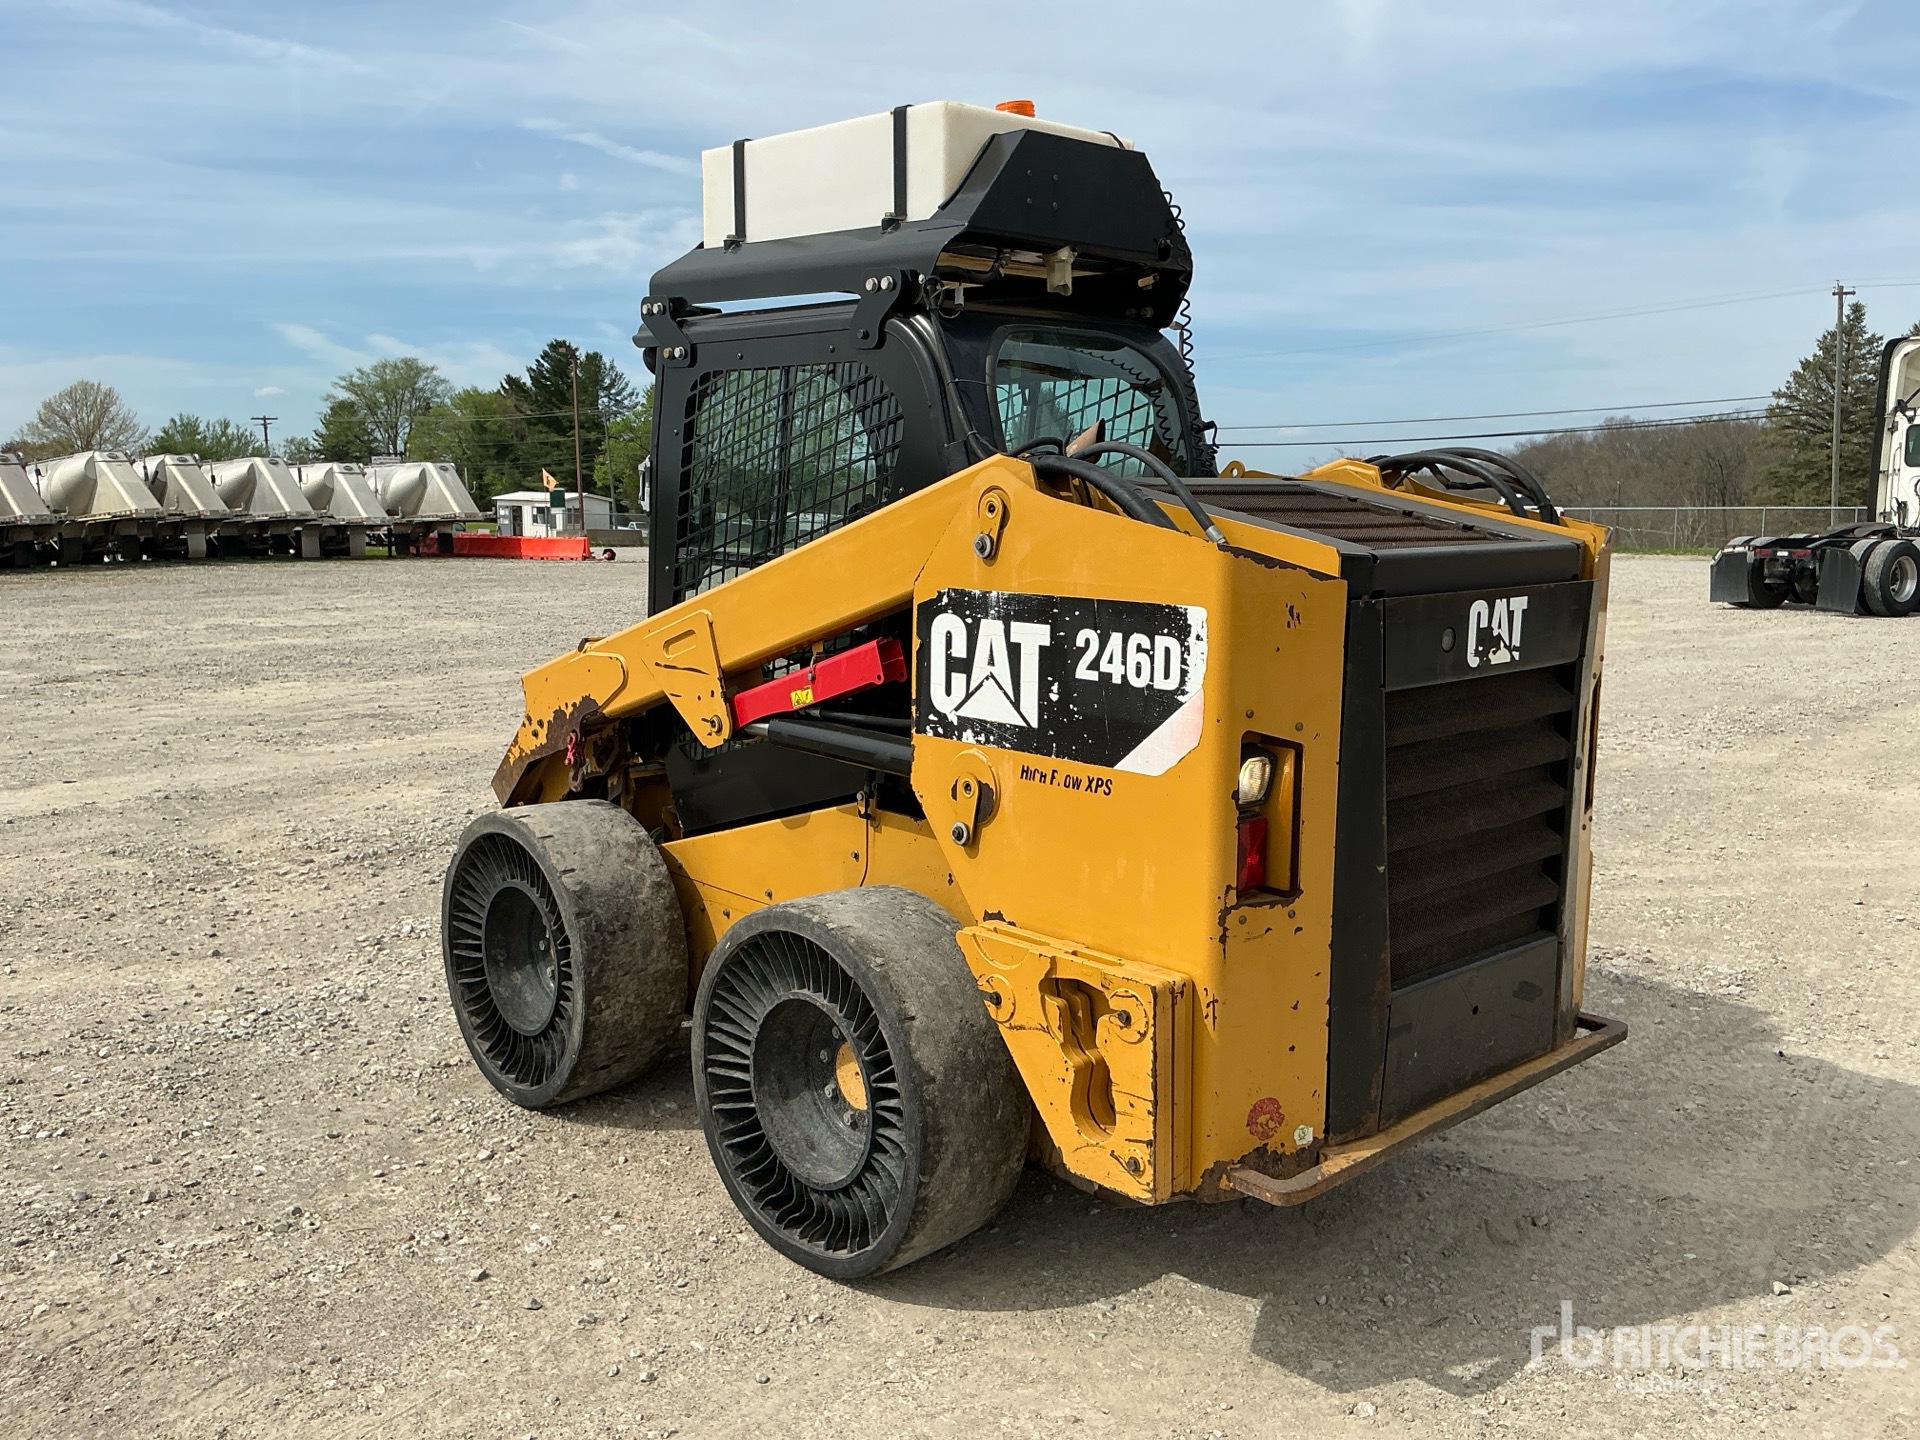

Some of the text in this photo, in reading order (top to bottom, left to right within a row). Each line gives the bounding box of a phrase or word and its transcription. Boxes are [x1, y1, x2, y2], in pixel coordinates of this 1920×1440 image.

[1467, 596, 1528, 668] CAT
[930, 613, 1181, 728] CAT 246D
[1085, 775, 1113, 796] XPS
